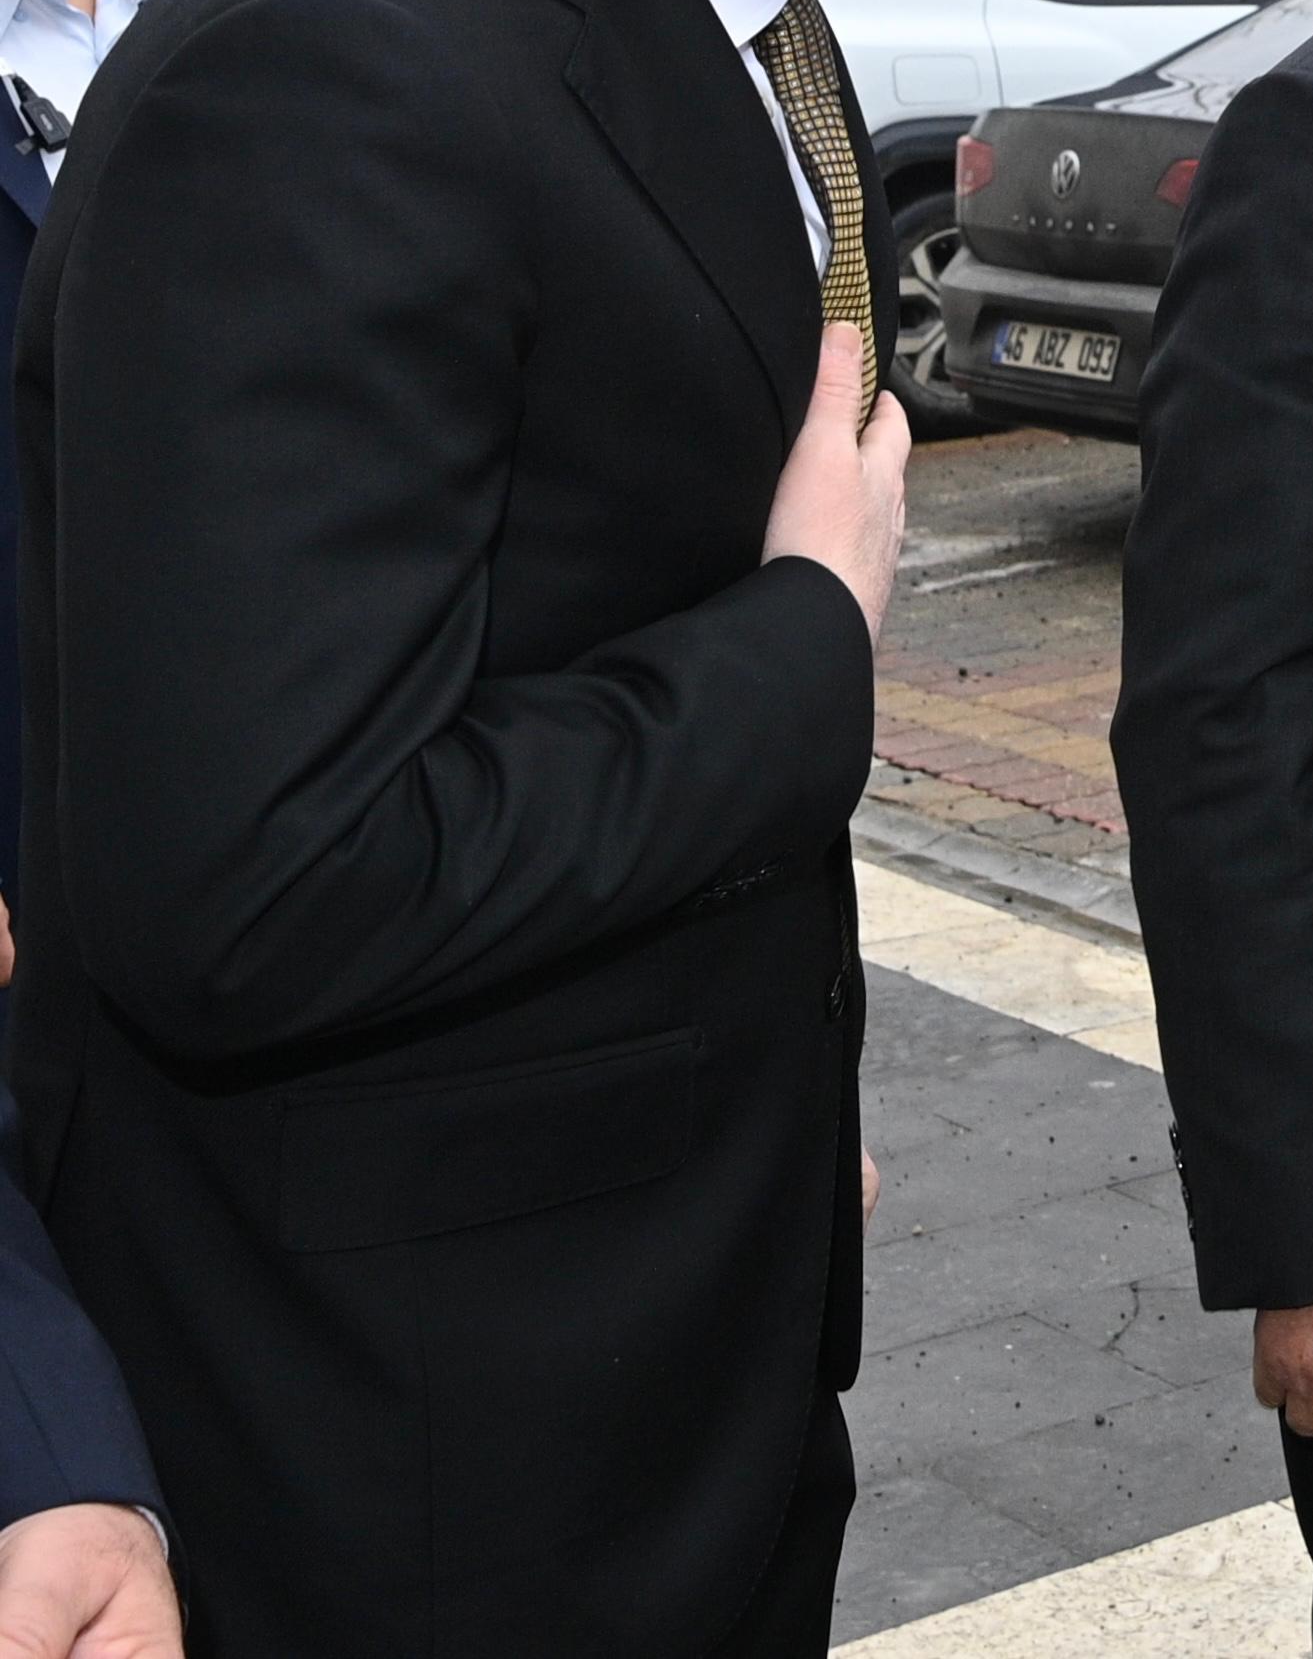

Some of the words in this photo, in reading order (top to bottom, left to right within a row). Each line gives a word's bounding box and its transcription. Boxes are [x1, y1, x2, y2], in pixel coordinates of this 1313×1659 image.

[1003, 324, 1028, 361] 46
[1033, 328, 1072, 369] ABZ
[1078, 336, 1118, 376] 093
